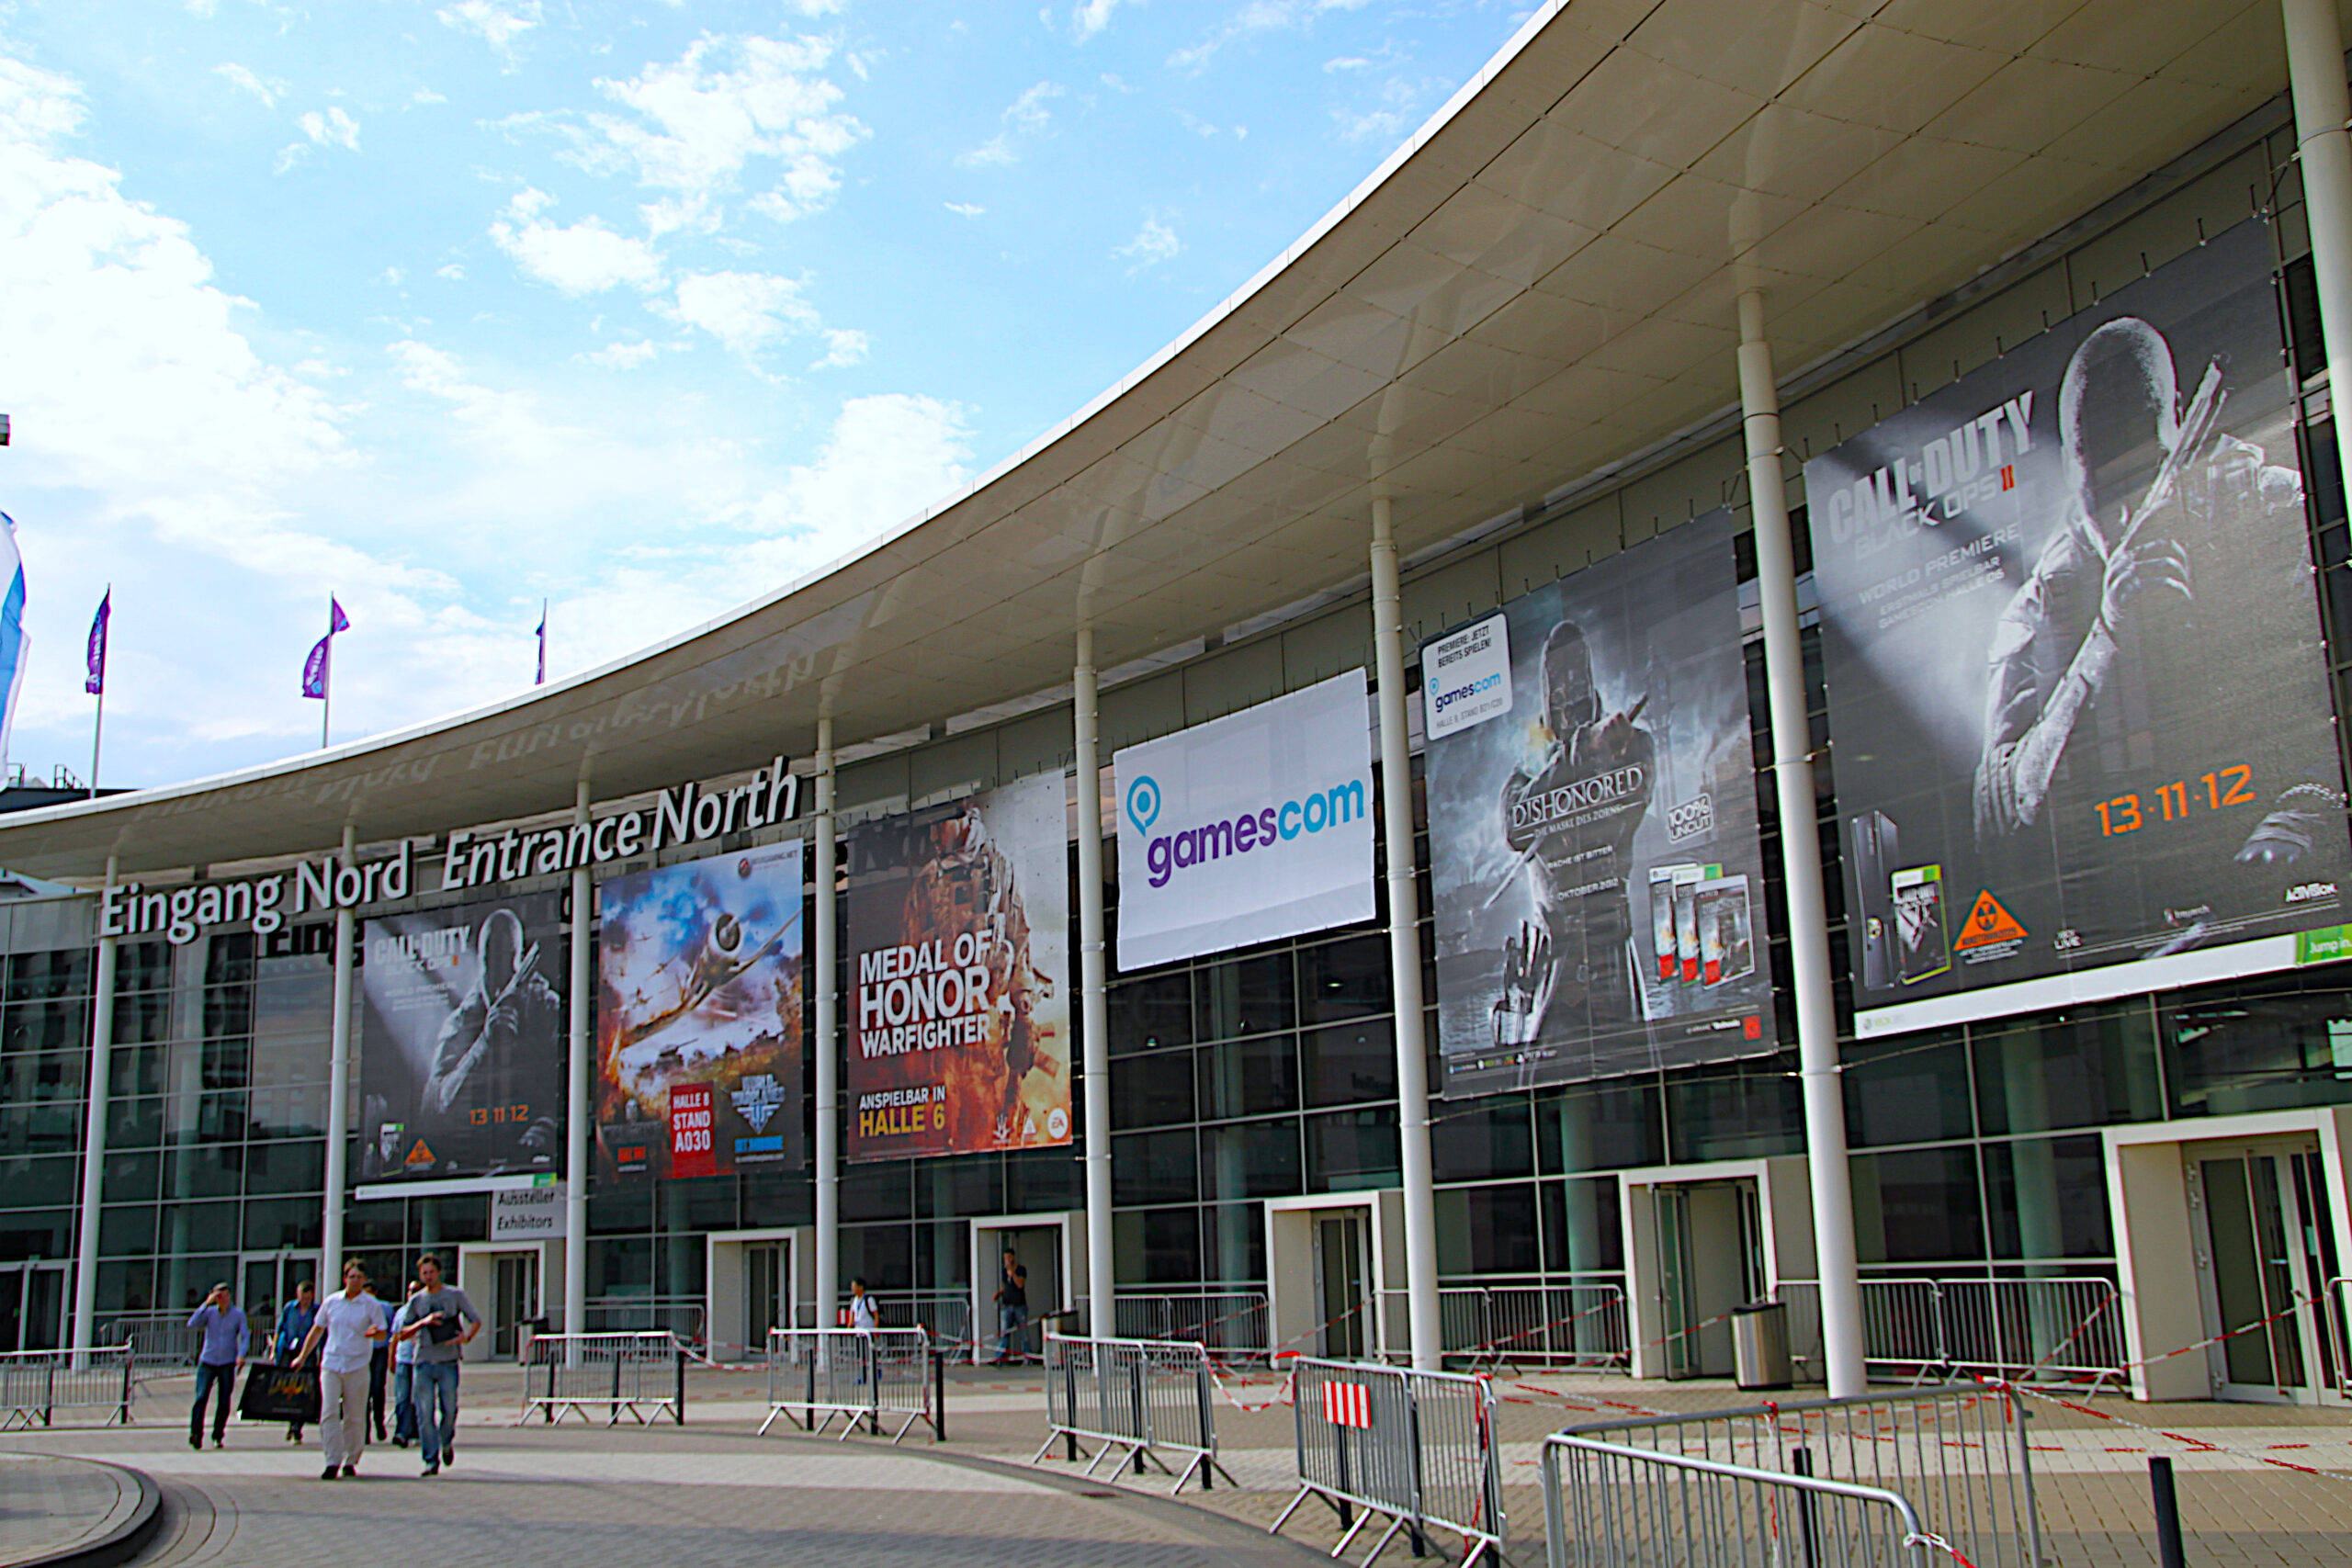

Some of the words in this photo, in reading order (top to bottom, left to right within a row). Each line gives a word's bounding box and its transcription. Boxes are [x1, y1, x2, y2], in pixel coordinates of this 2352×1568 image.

[1828, 457, 1917, 545] CALL
[1923, 389, 2034, 500] DUTY
[1943, 474, 1998, 520] OPS
[1859, 567, 1921, 606] WORLD
[1924, 521, 2021, 577] PREMIERE
[1435, 672, 1502, 713] gamescom
[1512, 766, 1643, 828] DISHONORED
[1668, 797, 1710, 829] 100%
[441, 809, 647, 891] Entrance
[649, 755, 803, 851] North
[1148, 779, 1365, 888] gamescom
[1669, 815, 1711, 840] UNCUT
[99, 874, 287, 946] Eingang
[294, 840, 415, 913] Nord
[1557, 883, 1599, 900] OKTOBER
[374, 933, 417, 964] CALL
[421, 925, 471, 958] DUTY
[860, 939, 948, 986] MEDAL
[954, 929, 993, 968] OF
[2310, 941, 2339, 954] Jump
[859, 964, 991, 1032] HONOR
[860, 1013, 991, 1059] WARFIGHTER
[673, 1095, 701, 1109] HALLE
[860, 1091, 929, 1111] ANSPIELBAR
[933, 1085, 946, 1101] IN
[673, 1110, 711, 1132] STAND
[859, 1102, 926, 1138] HALLE
[933, 1102, 945, 1131] 6
[674, 1129, 711, 1154] A030
[497, 1214, 553, 1231] Exhibitors
